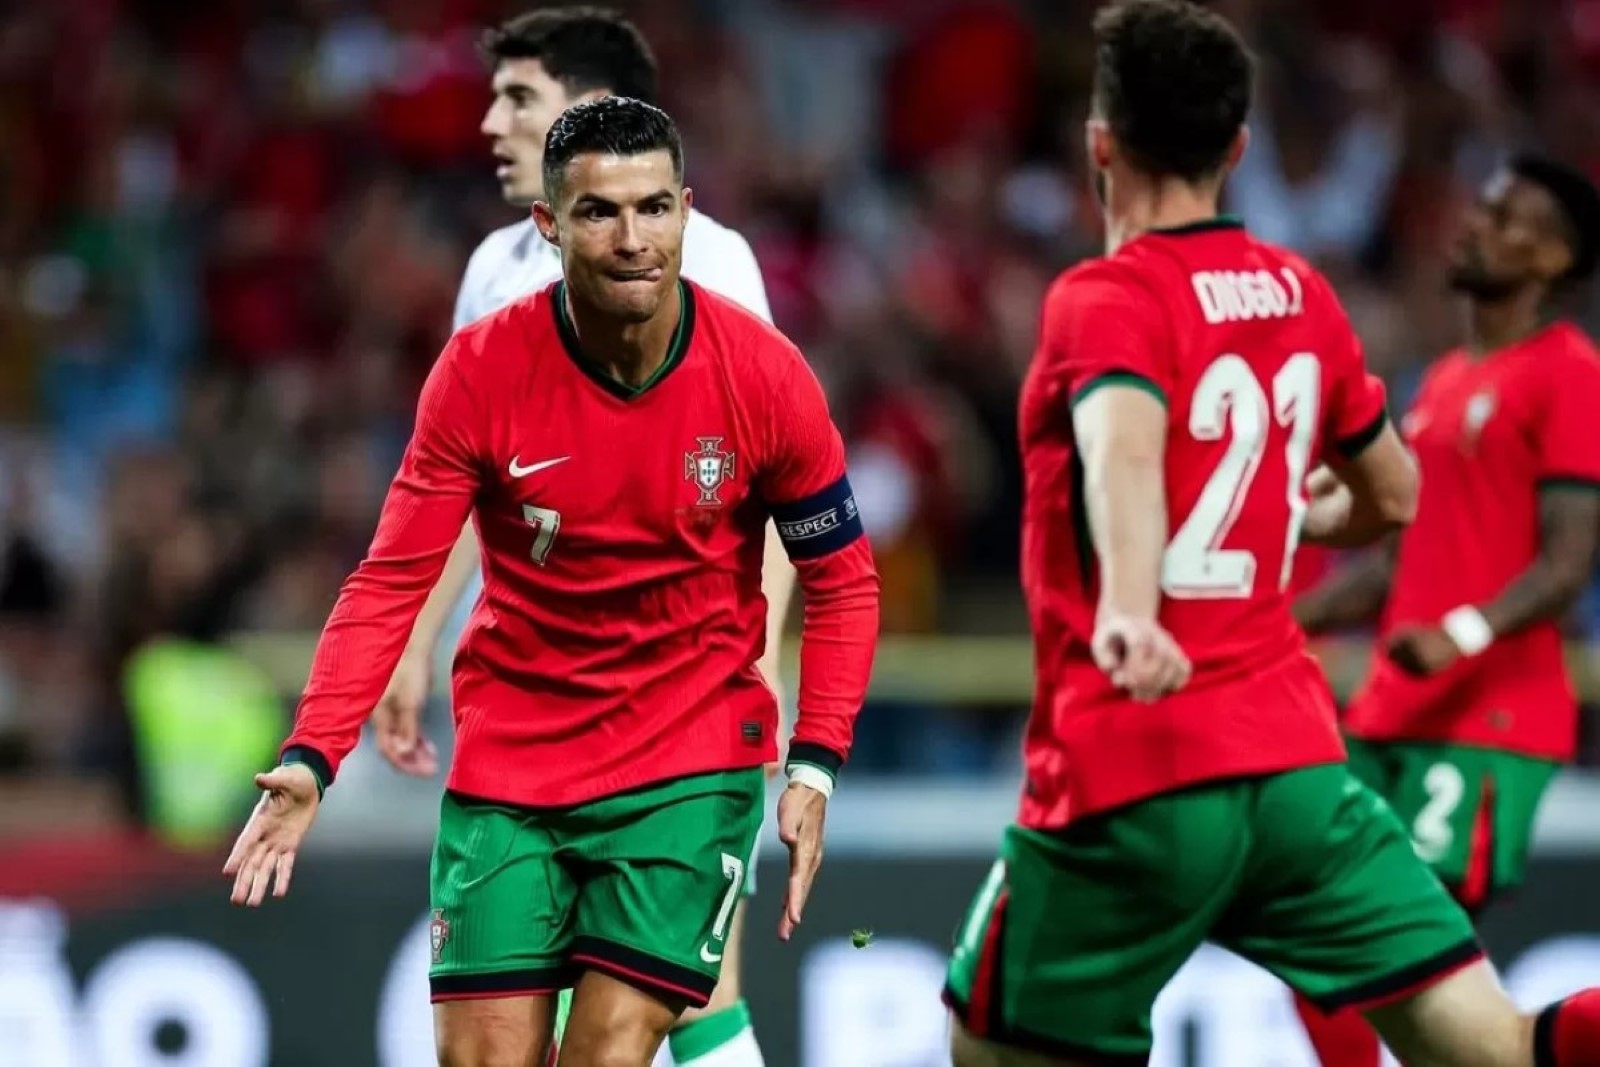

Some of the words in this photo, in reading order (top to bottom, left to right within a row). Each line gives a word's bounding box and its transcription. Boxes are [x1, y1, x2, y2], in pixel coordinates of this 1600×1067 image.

[1161, 353, 1322, 599] 21
[522, 504, 561, 566] 7
[781, 511, 838, 536] RESPECT
[1409, 761, 1466, 864] 2
[712, 852, 744, 940] 7
